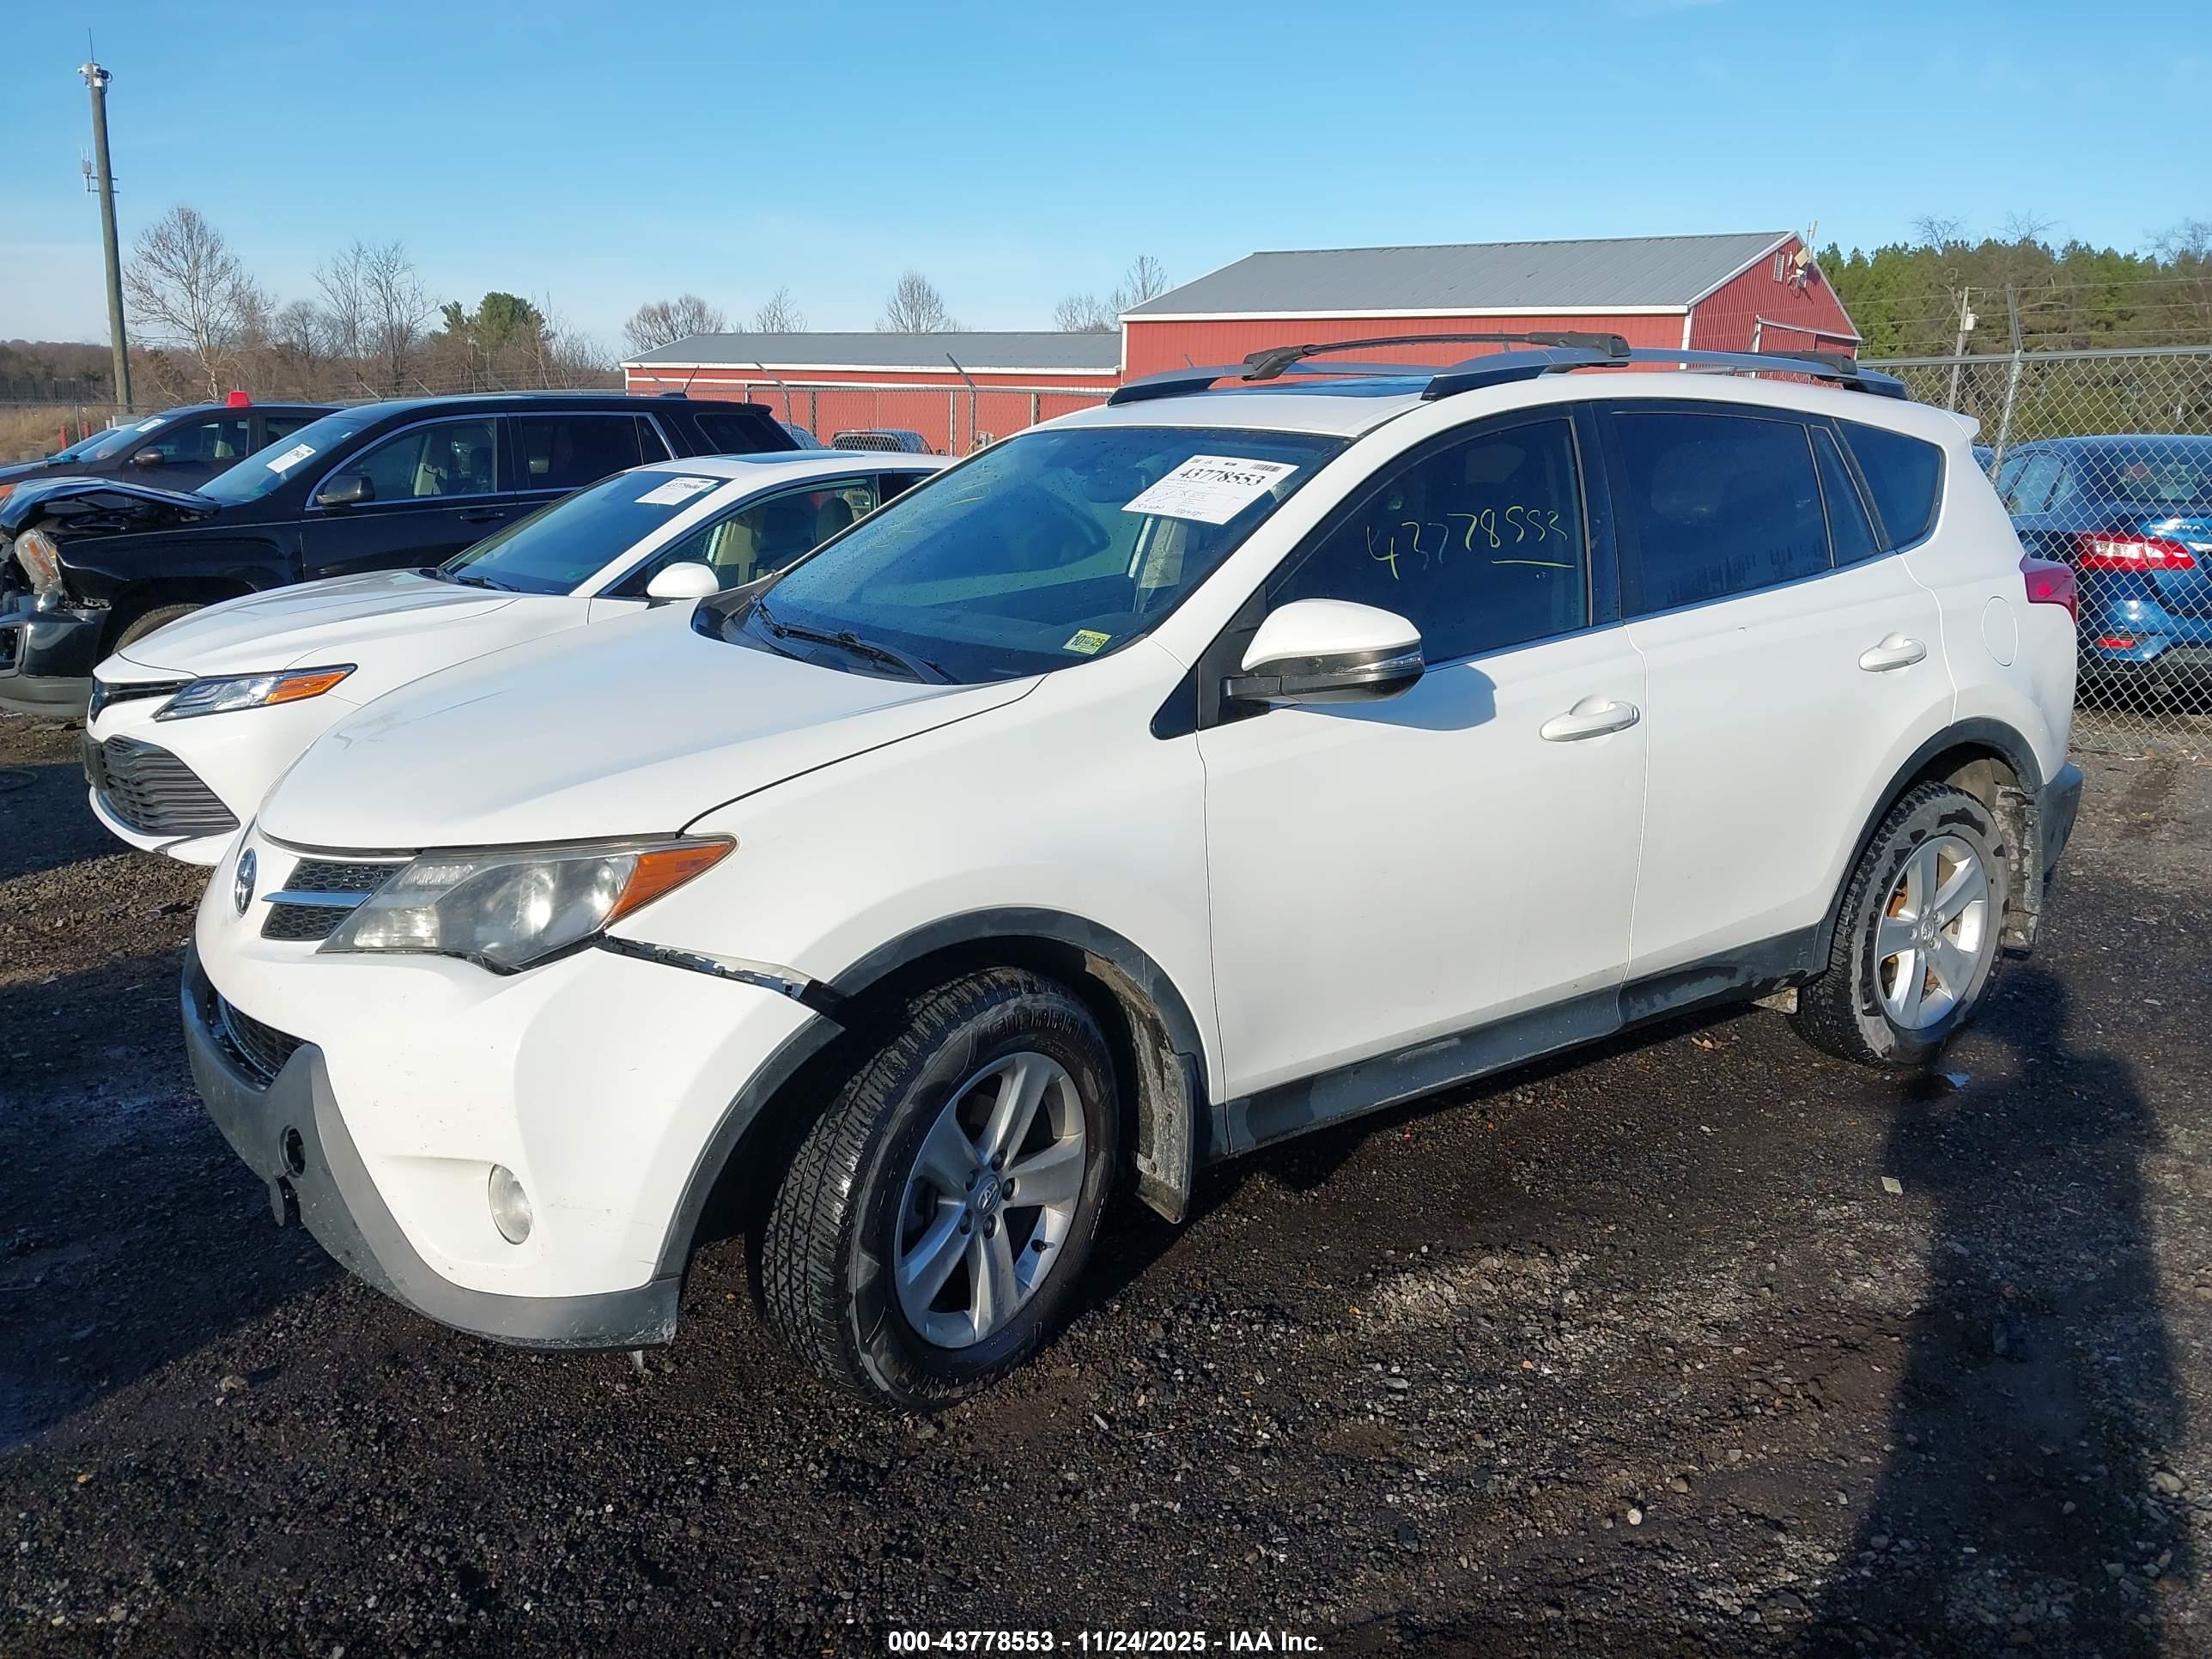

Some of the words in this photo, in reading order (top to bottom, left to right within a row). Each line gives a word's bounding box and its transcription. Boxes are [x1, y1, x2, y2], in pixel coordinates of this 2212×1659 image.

[1179, 467, 1267, 486] 43778553
[1070, 633, 1087, 647] 10
[1090, 637, 1106, 647] 25
